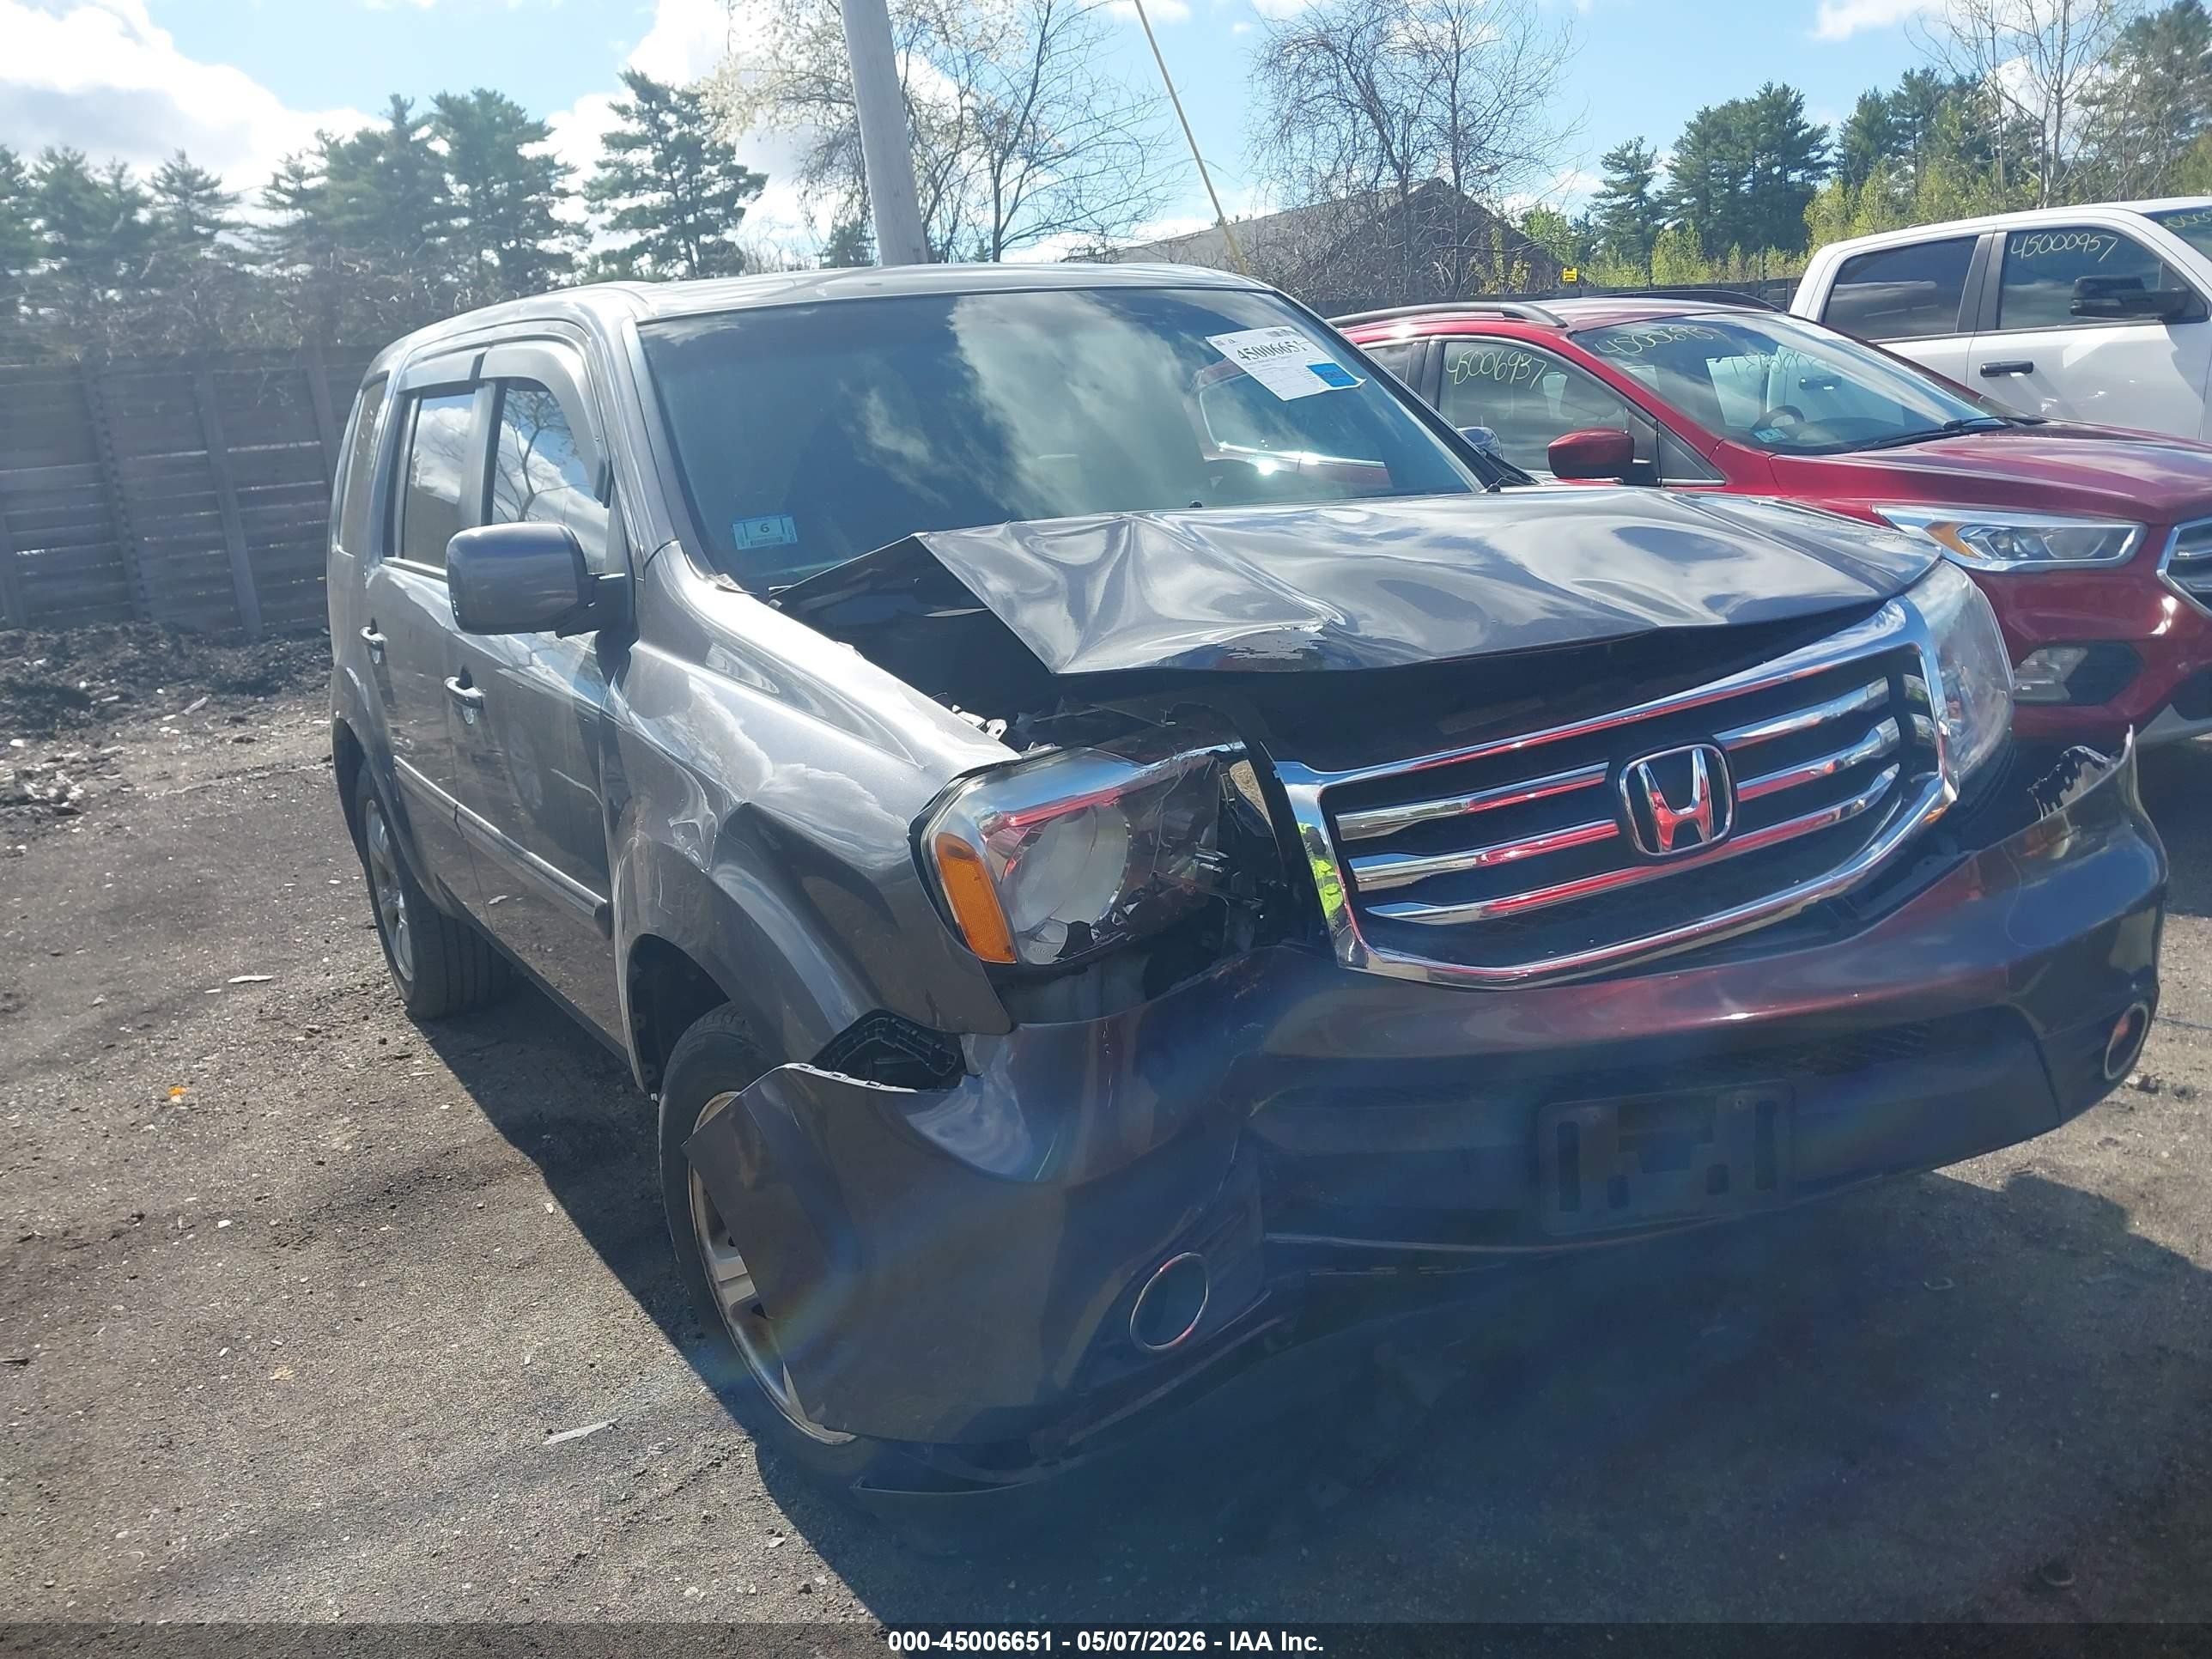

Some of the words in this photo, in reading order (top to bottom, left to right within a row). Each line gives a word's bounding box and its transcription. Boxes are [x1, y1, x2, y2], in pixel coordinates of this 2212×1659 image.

[2011, 233, 2118, 262] 45000957
[1237, 339, 1308, 361] 45006651
[1446, 350, 1547, 390] 45006937
[760, 523, 770, 533] 6
